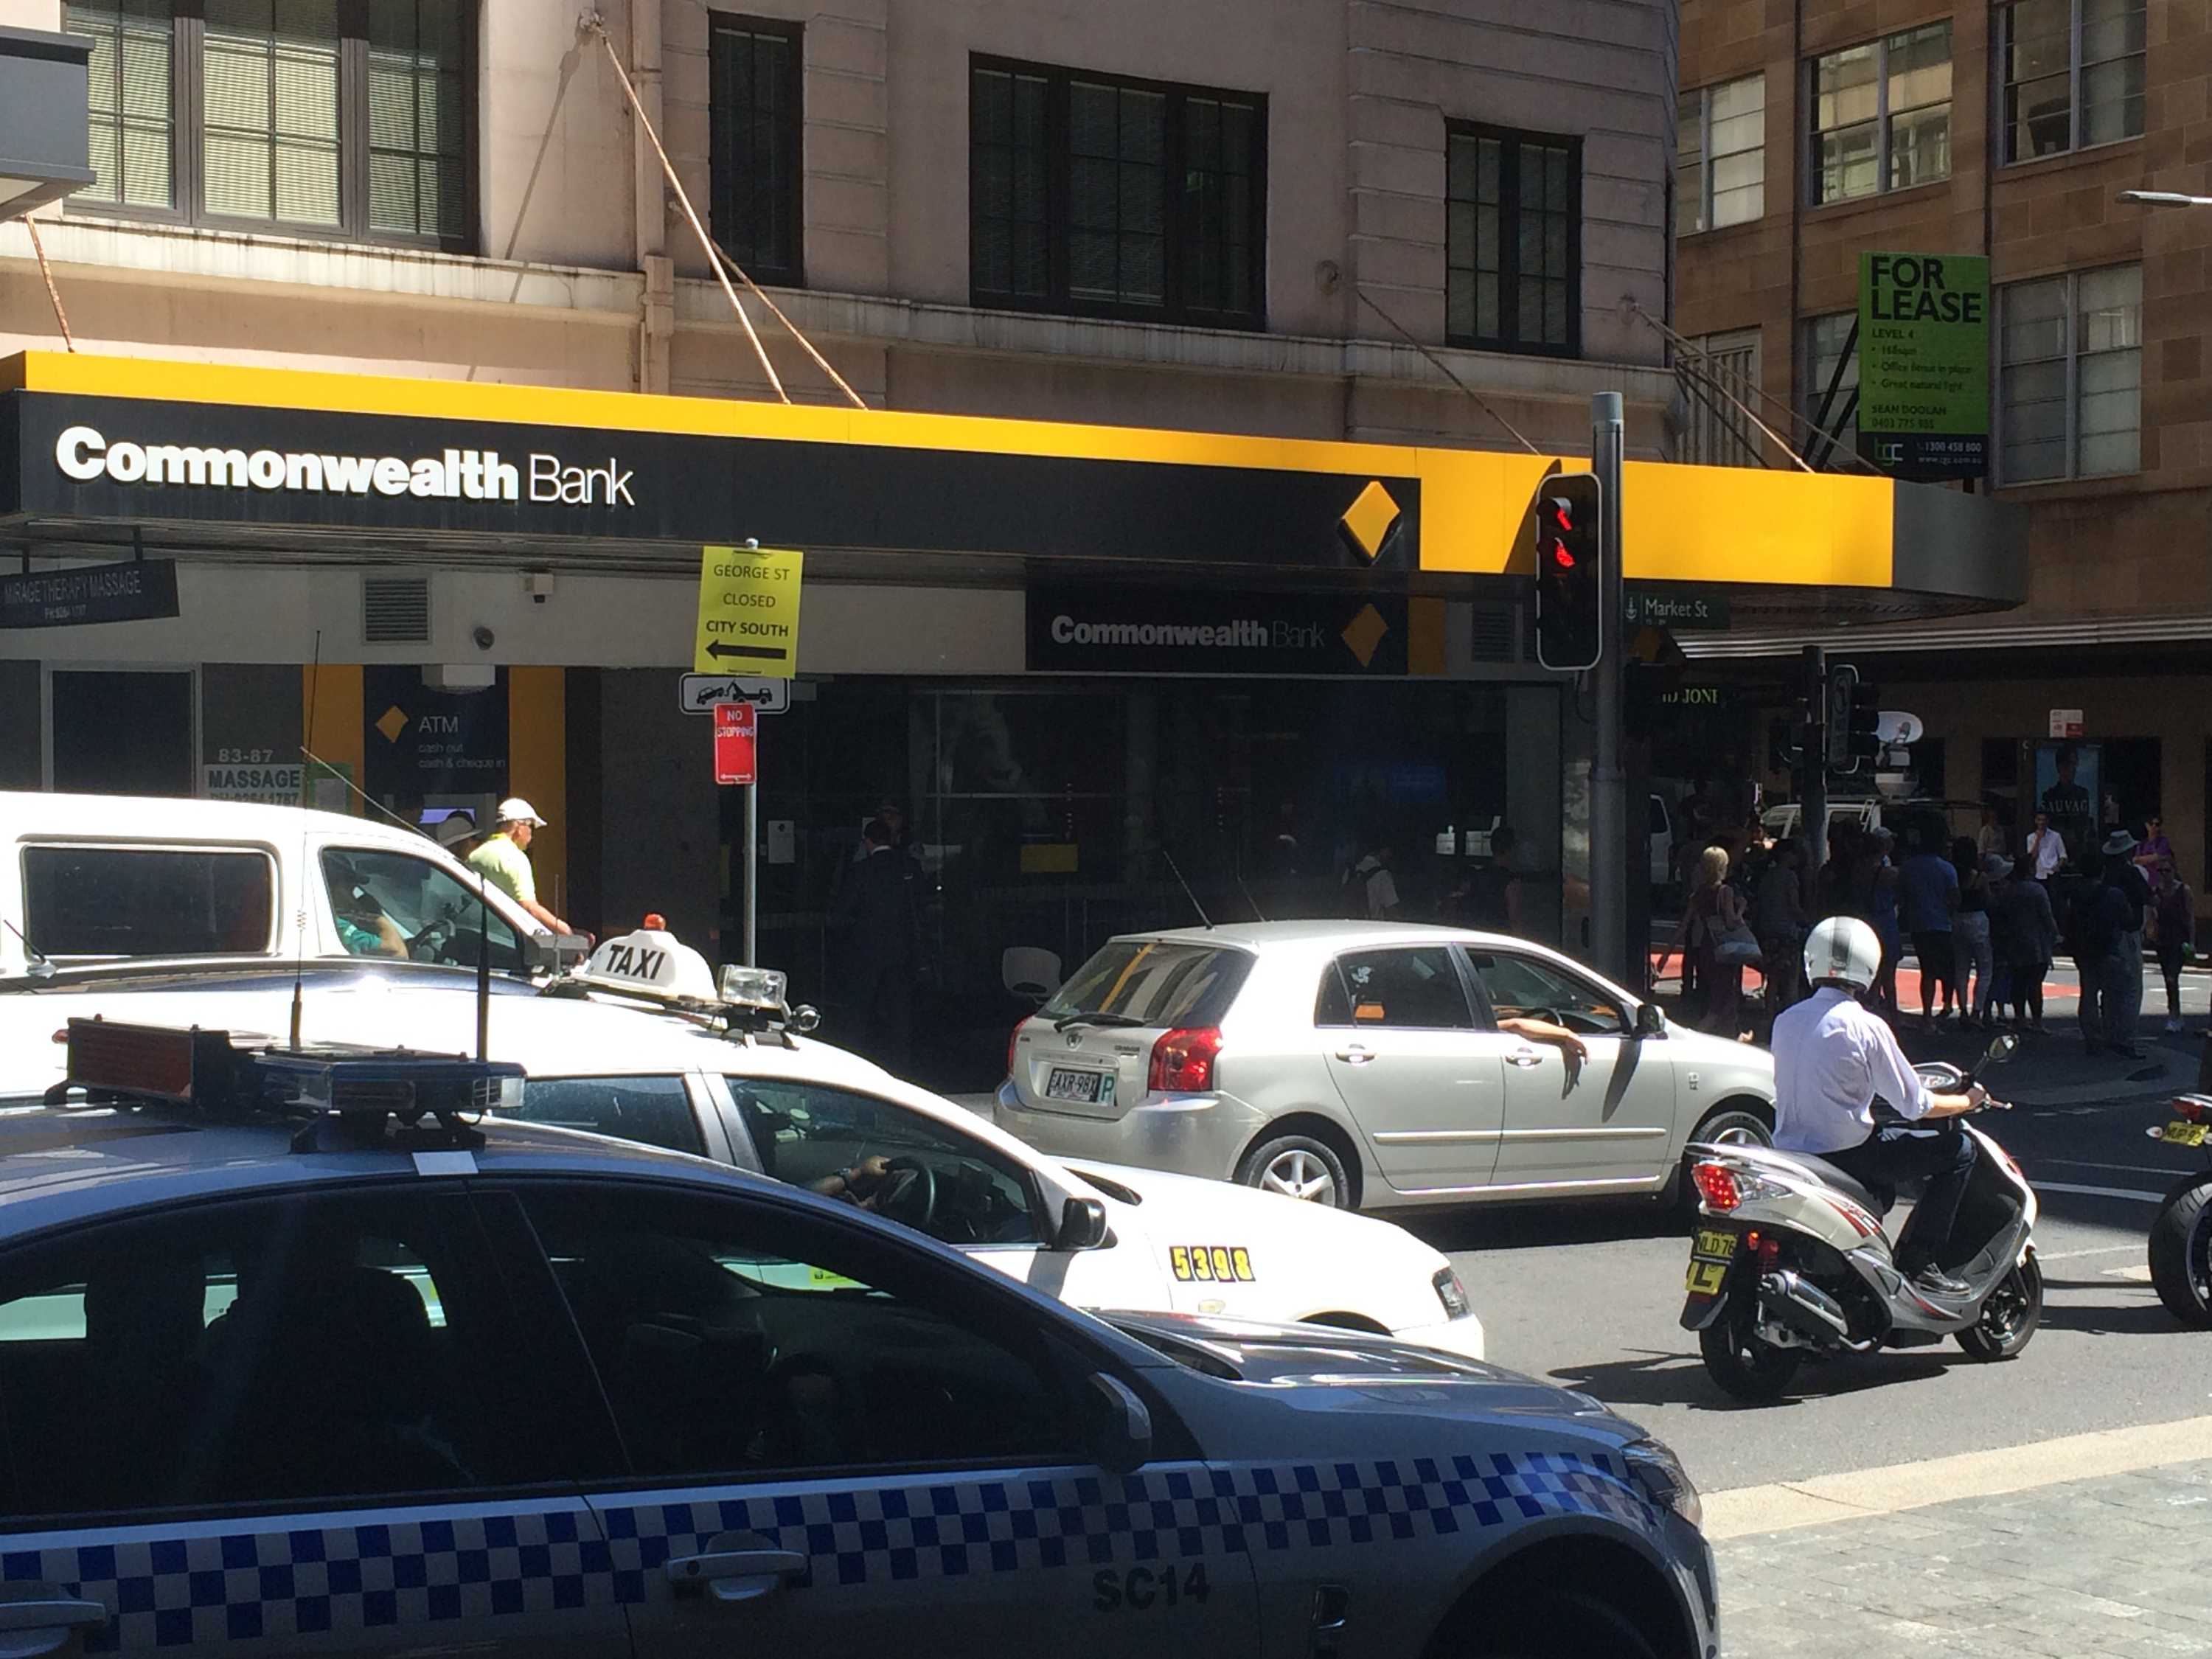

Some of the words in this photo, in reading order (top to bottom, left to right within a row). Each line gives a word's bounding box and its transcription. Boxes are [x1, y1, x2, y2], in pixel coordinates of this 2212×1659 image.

[1871, 256, 1946, 290] FOR
[1871, 288, 1982, 323] LEASE
[1872, 328, 1905, 338] LEVEL
[1908, 329, 1914, 338] 4
[1882, 378, 1908, 389] Great
[55, 425, 521, 501] Commonwealth
[529, 452, 636, 509] Bank
[713, 563, 769, 580] GEORGE
[774, 567, 790, 581] ST
[89, 570, 142, 598] MASSAGE
[723, 592, 776, 608] CLOSED
[1645, 597, 1692, 618] Market
[1694, 599, 1709, 619] St
[706, 619, 737, 634] CITY
[740, 622, 789, 637] SOUTH
[1050, 615, 1268, 648] Commonwealth
[1272, 619, 1326, 649] Bank
[726, 709, 743, 721] NO
[418, 715, 459, 734] ATM
[717, 726, 754, 738] STOPPING
[218, 748, 274, 763] 83-87
[418, 742, 444, 753] cash
[418, 758, 444, 768] cash
[445, 757, 454, 769] &
[209, 770, 300, 788] MASSAGE
[2039, 799, 2093, 813] SAUVAG
[605, 943, 666, 980] TAXI
[1100, 1076, 1115, 1102] P
[1171, 1246, 1254, 1281] 5398
[1693, 1263, 1712, 1287] L
[1093, 1562, 1211, 1613] SC14
